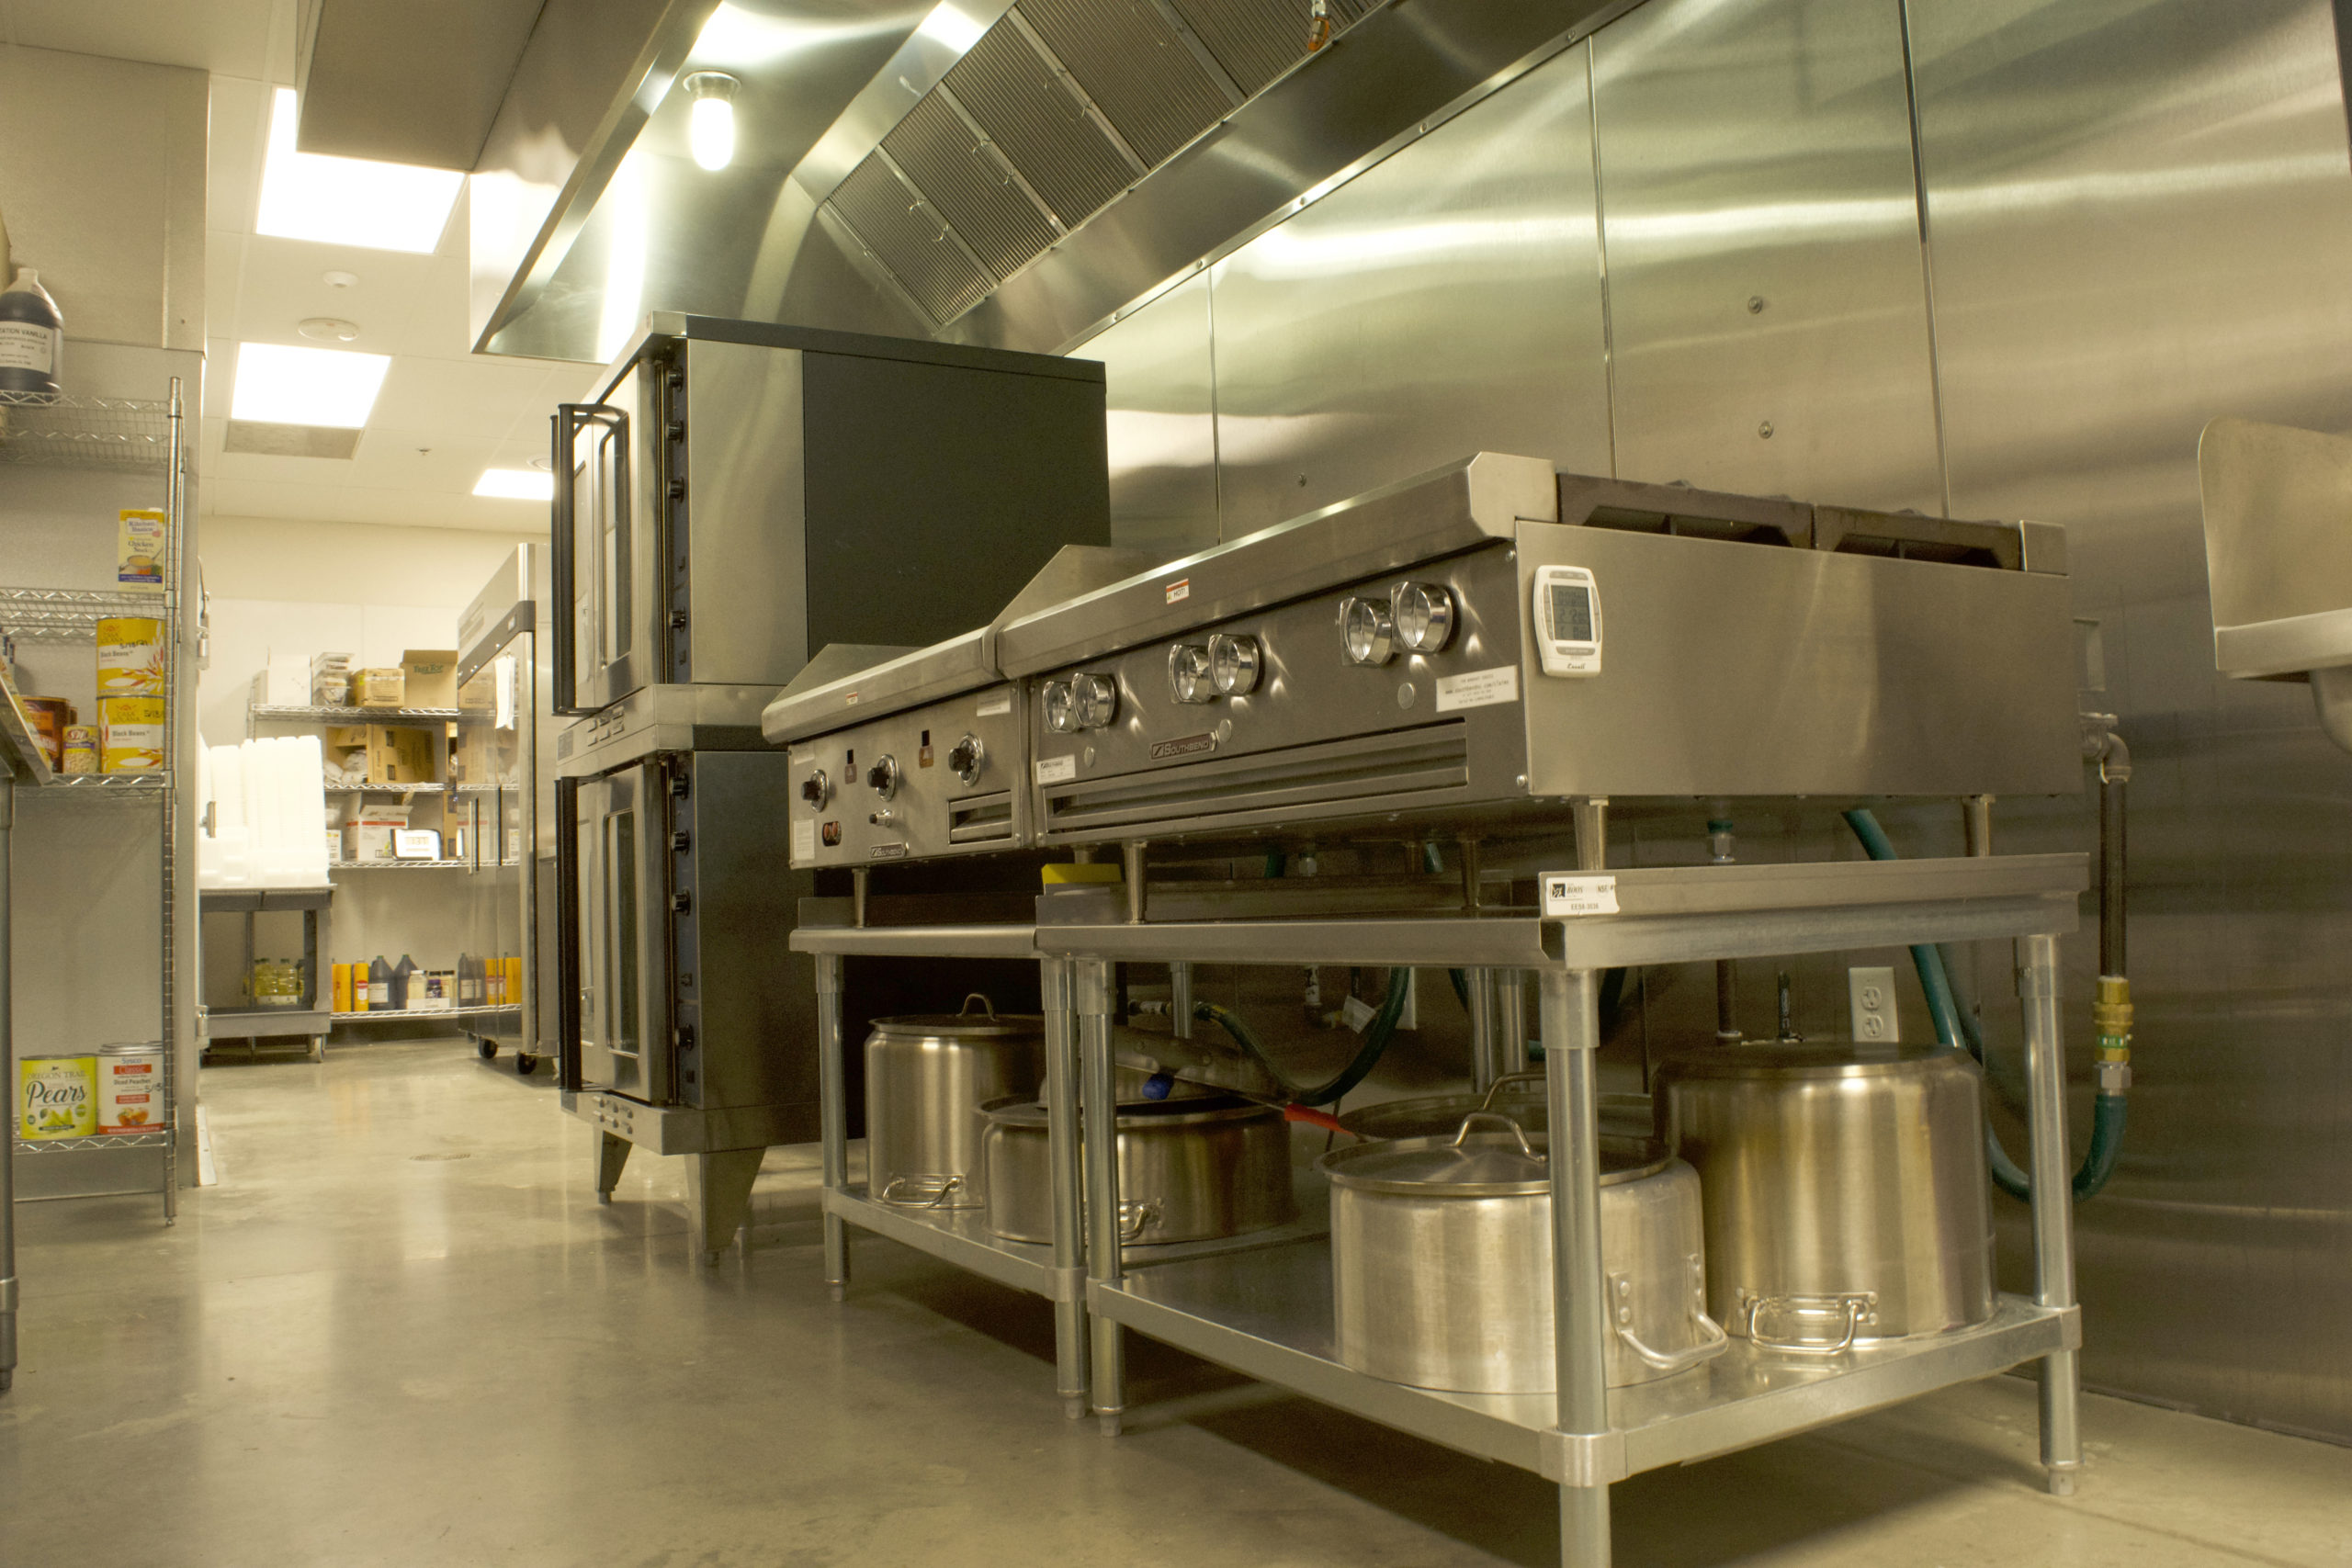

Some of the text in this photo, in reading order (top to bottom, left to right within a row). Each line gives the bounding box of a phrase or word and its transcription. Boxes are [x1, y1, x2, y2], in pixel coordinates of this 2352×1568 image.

[22, 330, 48, 339] VANILLA
[1164, 739, 1209, 757] SOUTHBEND
[27, 1080, 87, 1109] Pears
